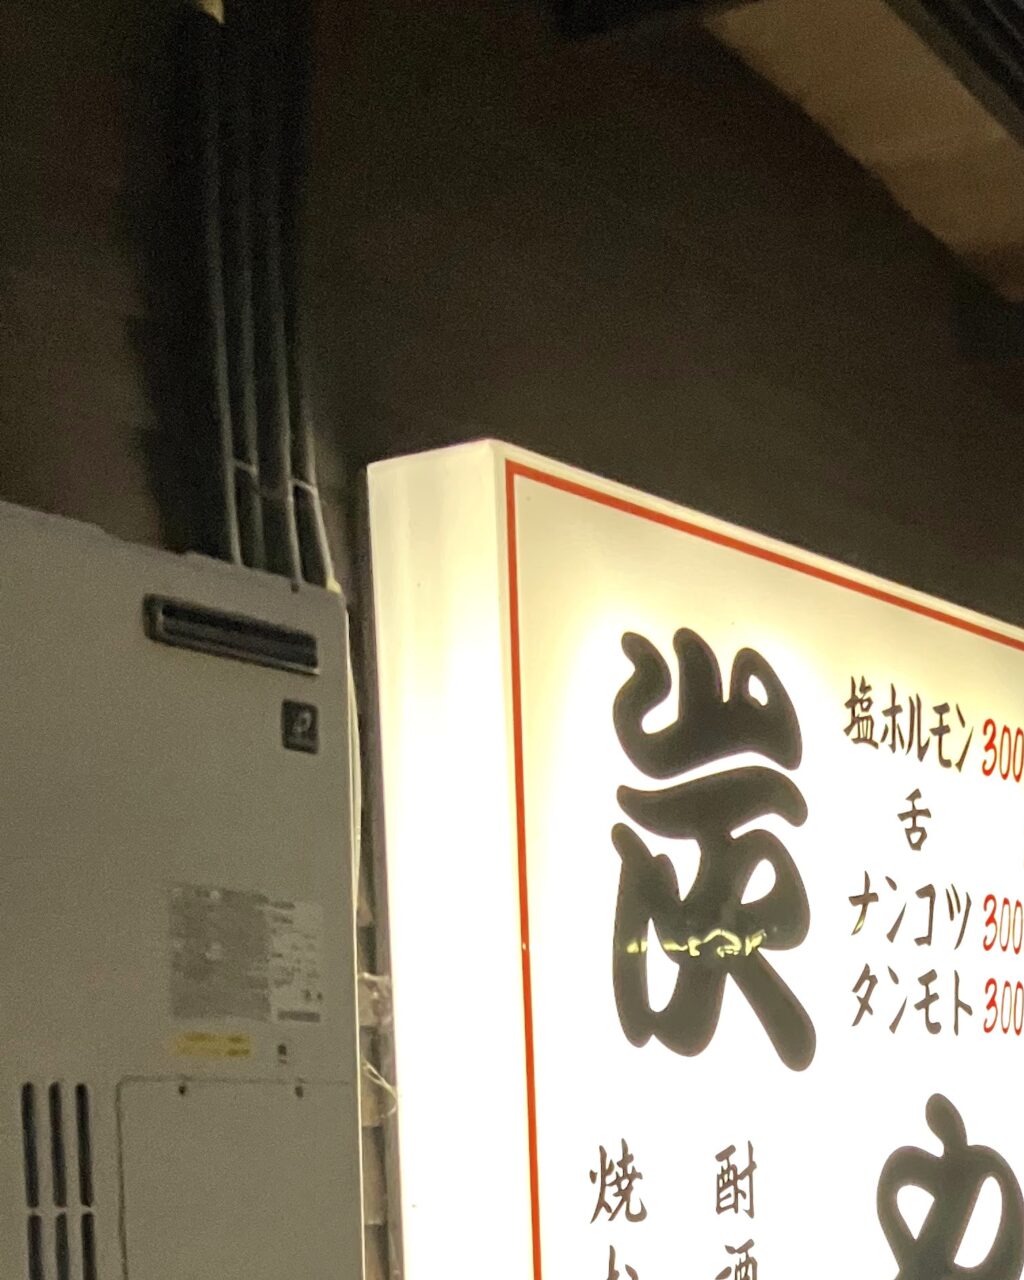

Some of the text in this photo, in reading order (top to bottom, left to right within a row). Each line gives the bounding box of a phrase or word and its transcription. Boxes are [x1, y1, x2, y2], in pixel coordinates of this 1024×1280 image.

[843, 676, 974, 773] 塩ホルモン
[611, 627, 817, 1072] 炭
[897, 788, 932, 851] 舌
[848, 871, 972, 950] ナンコツ
[851, 963, 1024, 1036] タンモト 300
